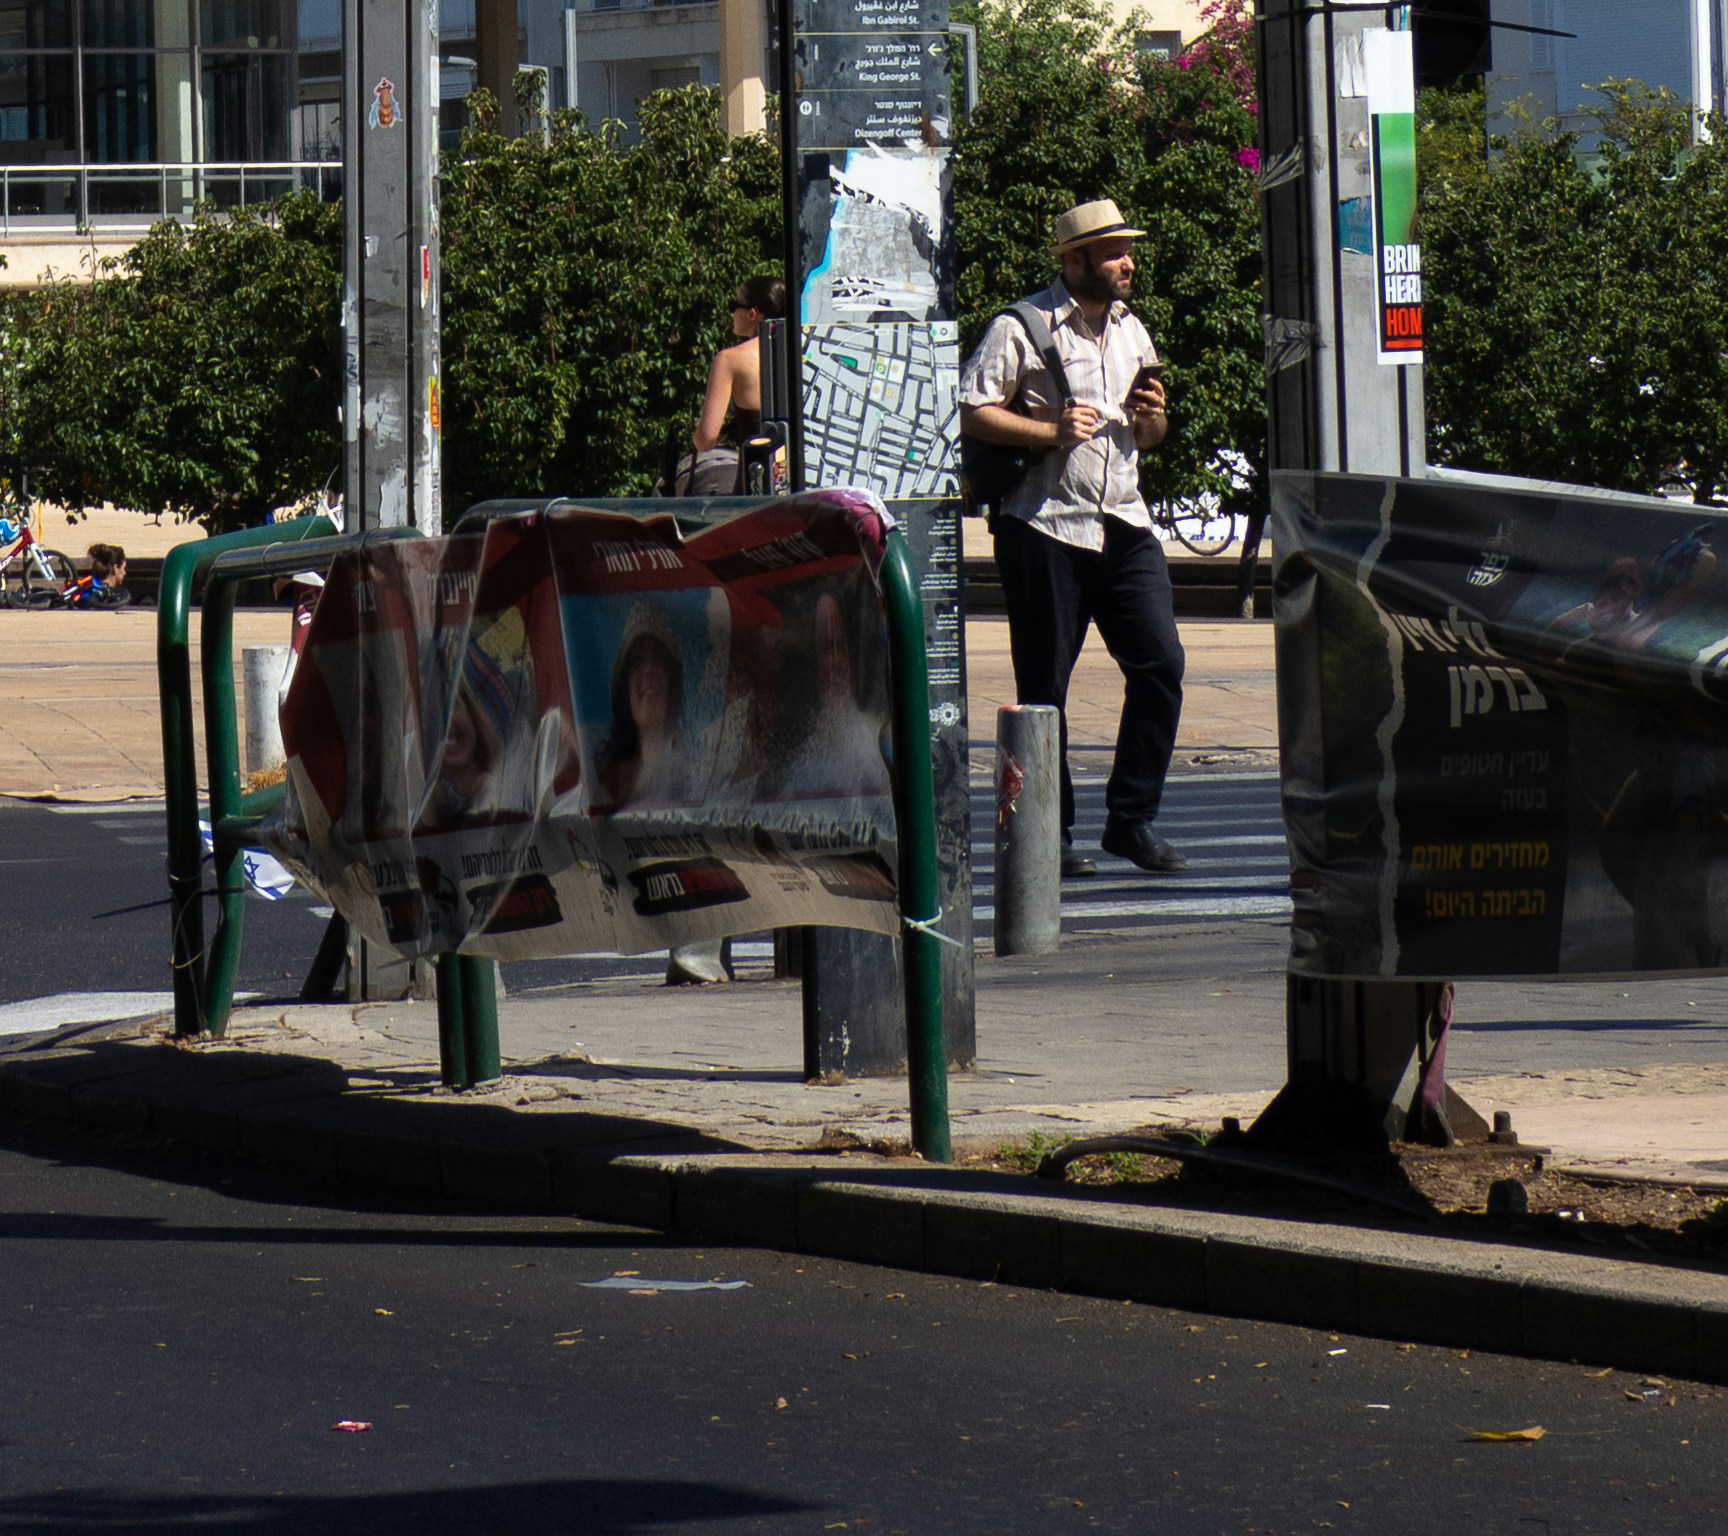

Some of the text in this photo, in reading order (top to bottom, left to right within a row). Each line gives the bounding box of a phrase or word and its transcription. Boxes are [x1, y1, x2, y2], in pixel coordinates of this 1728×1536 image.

[862, 15, 920, 24] Ibn Gabirol St.
[859, 71, 921, 83] King George St.
[854, 128, 923, 139] Dizengoff Center
[1480, 551, 1510, 568] כפר
[1439, 605, 1507, 660] גלי
[1448, 665, 1548, 728] ברמן
[1440, 750, 1550, 779] עדיין חטופים
[1502, 788, 1547, 812] בעזה
[1410, 840, 1551, 870] מחזירים אותם
[645, 872, 687, 901] בראש
[1424, 888, 1547, 918] הביתה היום!
